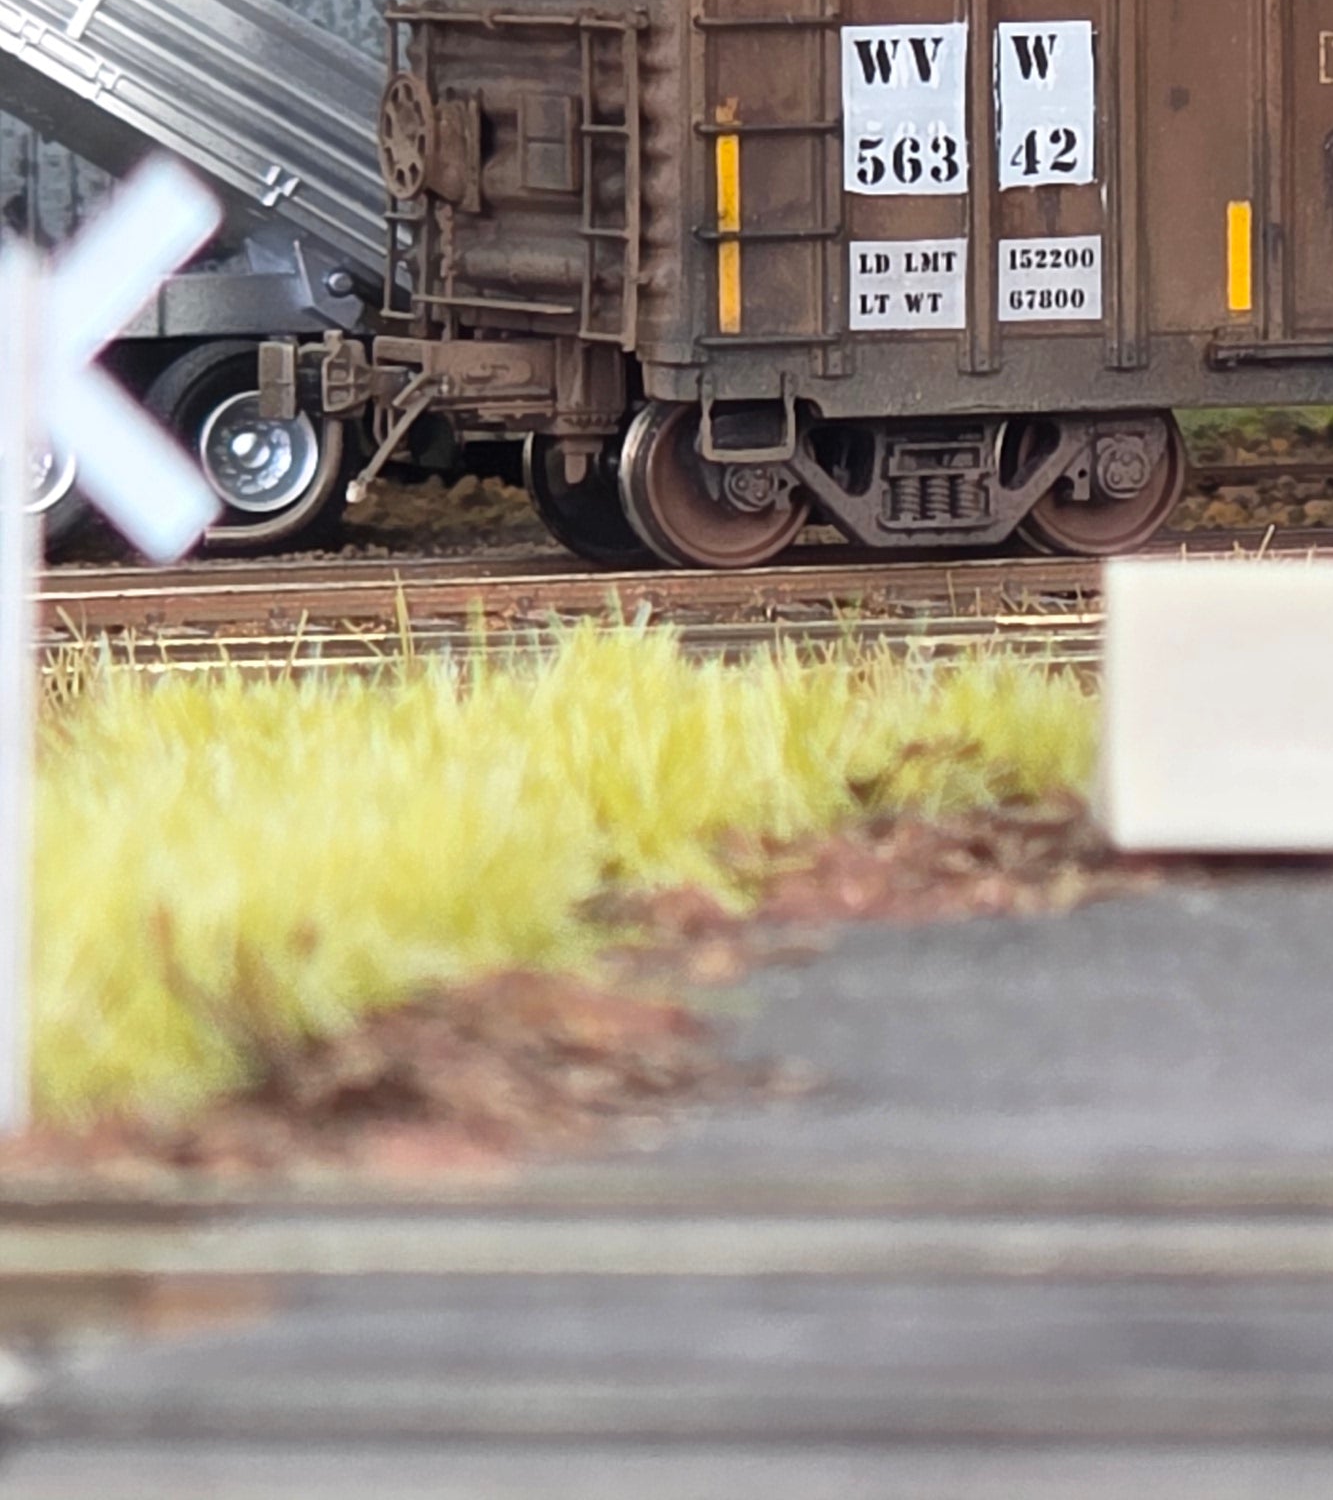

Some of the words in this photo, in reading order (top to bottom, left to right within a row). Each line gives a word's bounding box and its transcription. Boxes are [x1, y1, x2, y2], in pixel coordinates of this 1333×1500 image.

[858, 252, 891, 275] LD
[904, 250, 958, 274] LMT
[1008, 247, 1095, 271] 152200
[858, 294, 891, 316] LT
[904, 292, 943, 314] WT
[1008, 288, 1086, 311] 67800
